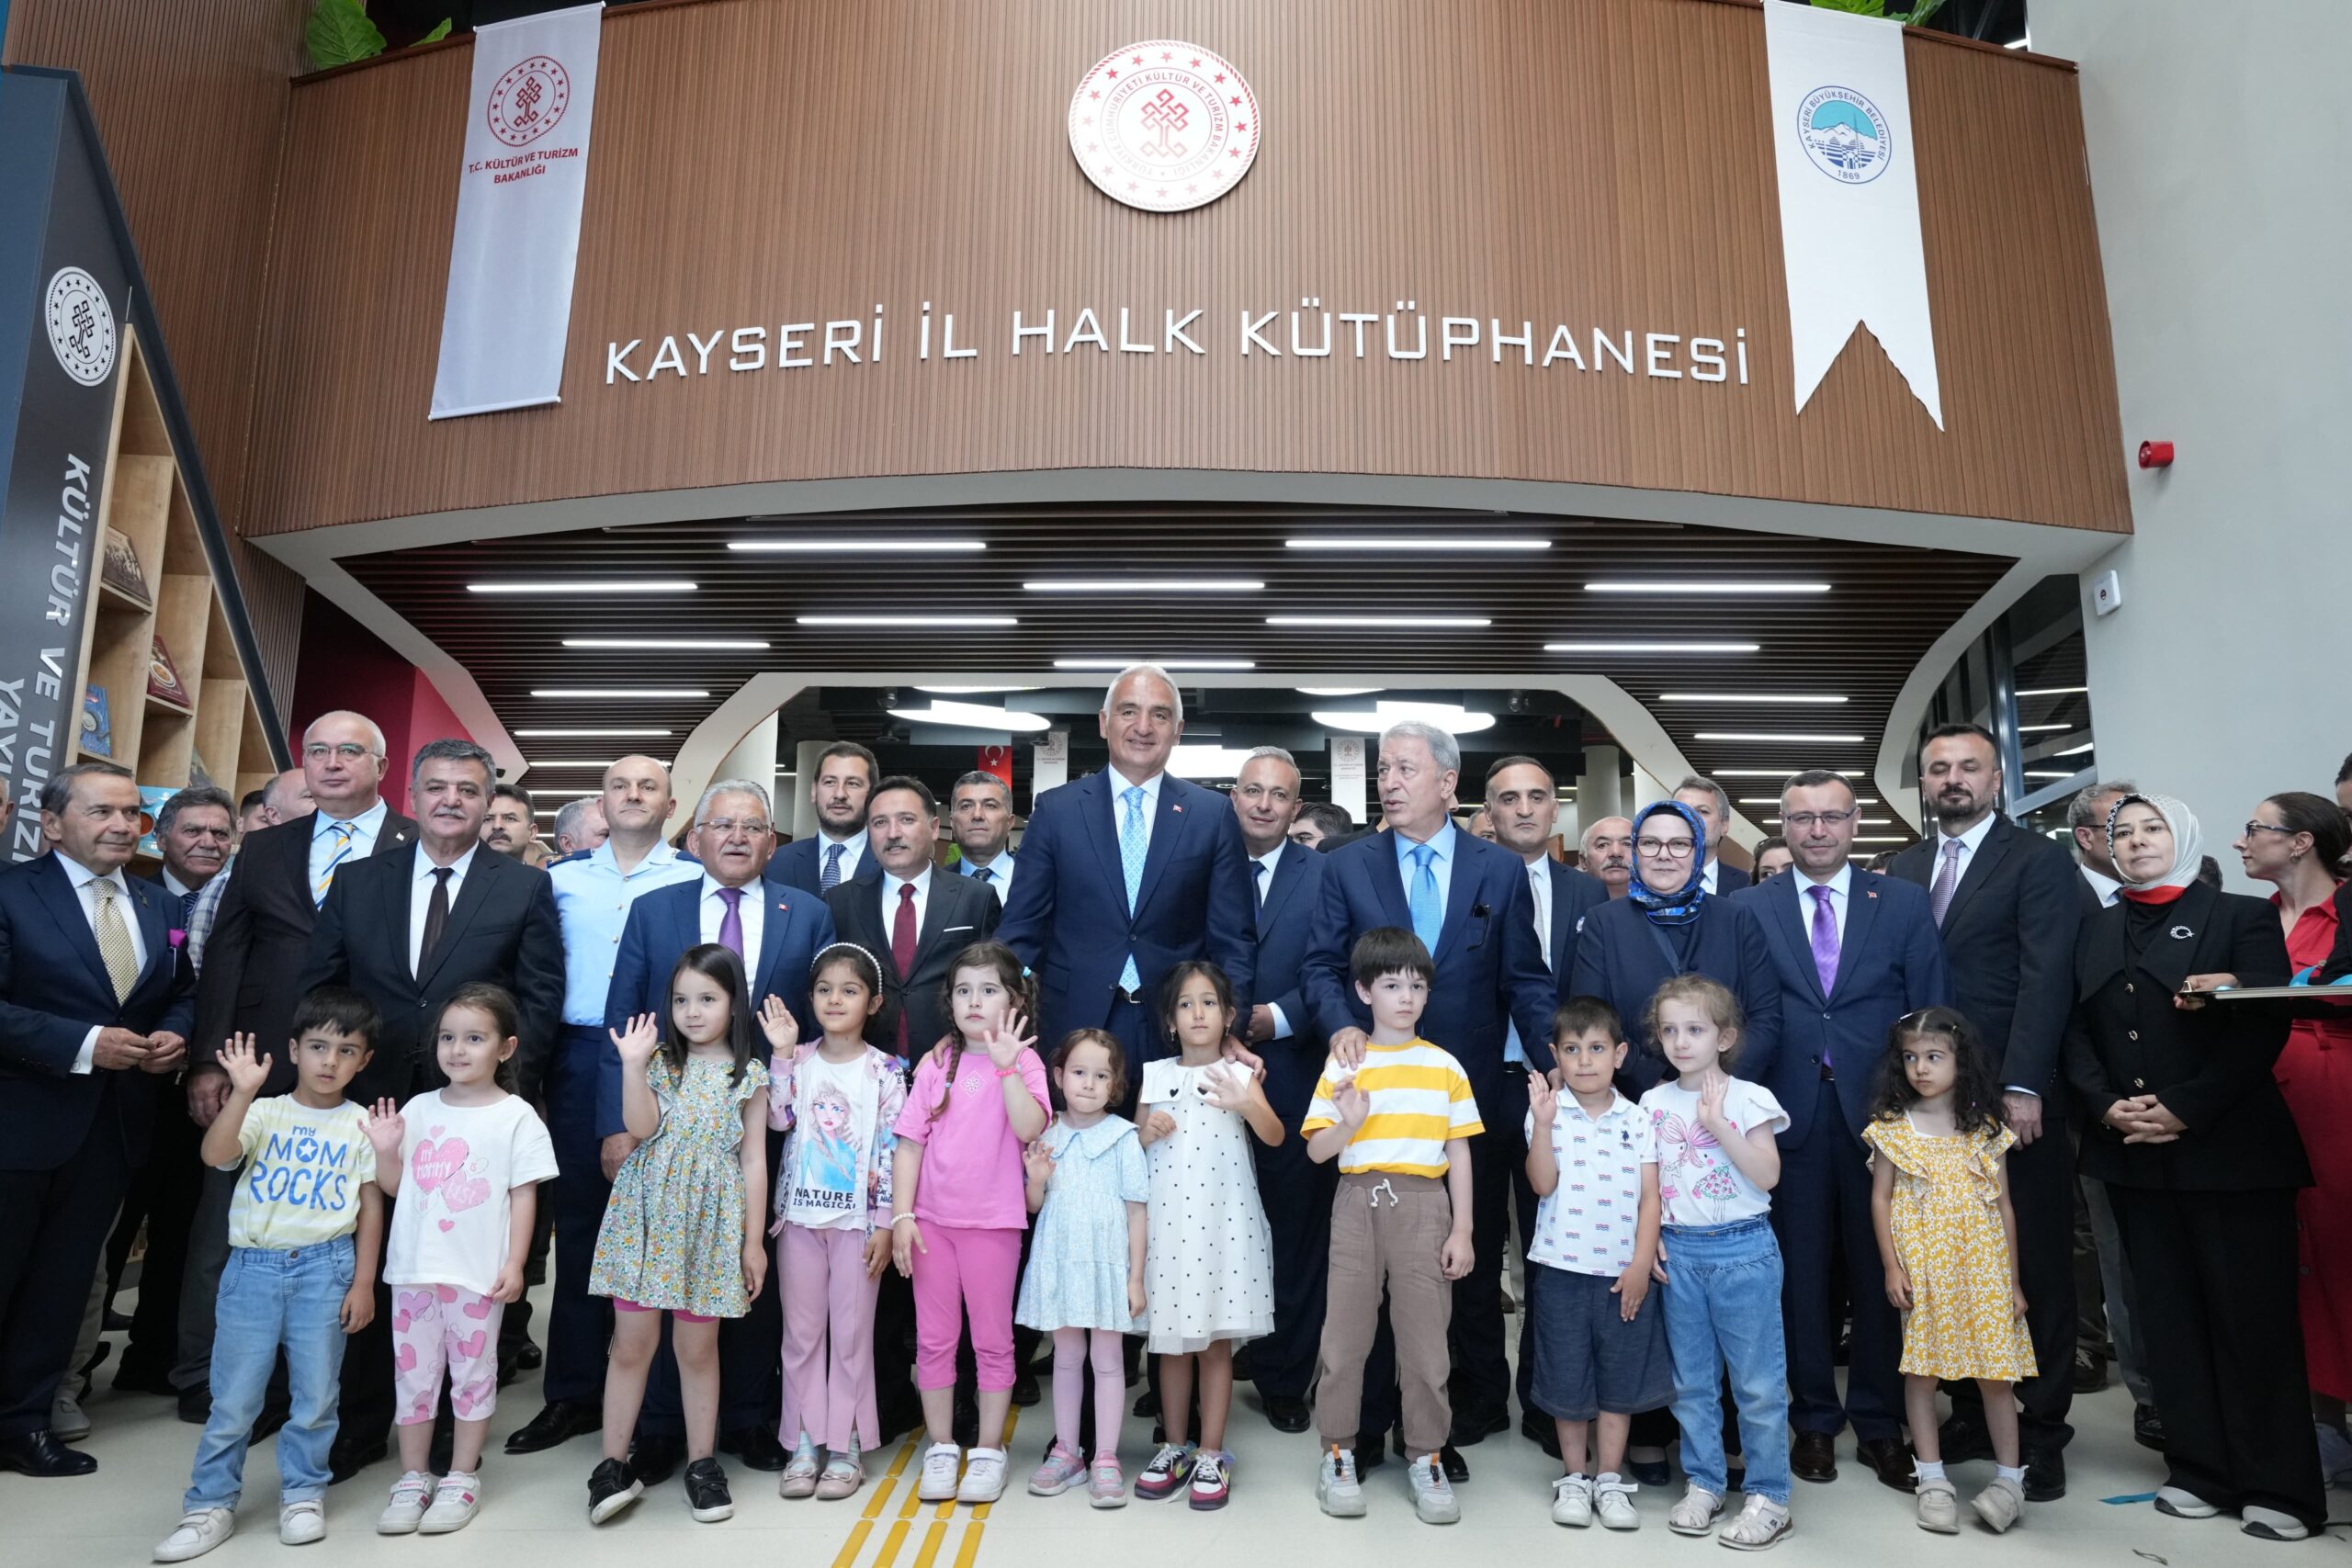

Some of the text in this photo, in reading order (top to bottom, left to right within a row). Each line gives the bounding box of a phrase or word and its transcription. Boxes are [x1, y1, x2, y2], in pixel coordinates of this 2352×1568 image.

[1145, 72, 1191, 85] KÜLTÜR
[1192, 81, 1206, 94] VE
[1204, 93, 1224, 131] TURİZM
[468, 147, 579, 174] T.C. KÜLTÜR VE TURİZM
[493, 164, 546, 184] BAKANLIĞI
[1838, 170, 1860, 180] 1869
[605, 297, 1749, 385] KAYSERİ İL HALK KÜTÜPHANESİ
[46, 453, 91, 626] KÜLTÜR
[35, 648, 65, 701] VE
[291, 1125, 317, 1136] my
[264, 1133, 347, 1168] MOM
[250, 1160, 347, 1211] ROCKS
[795, 1187, 854, 1202] NATURE
[793, 1198, 803, 1206] IS
